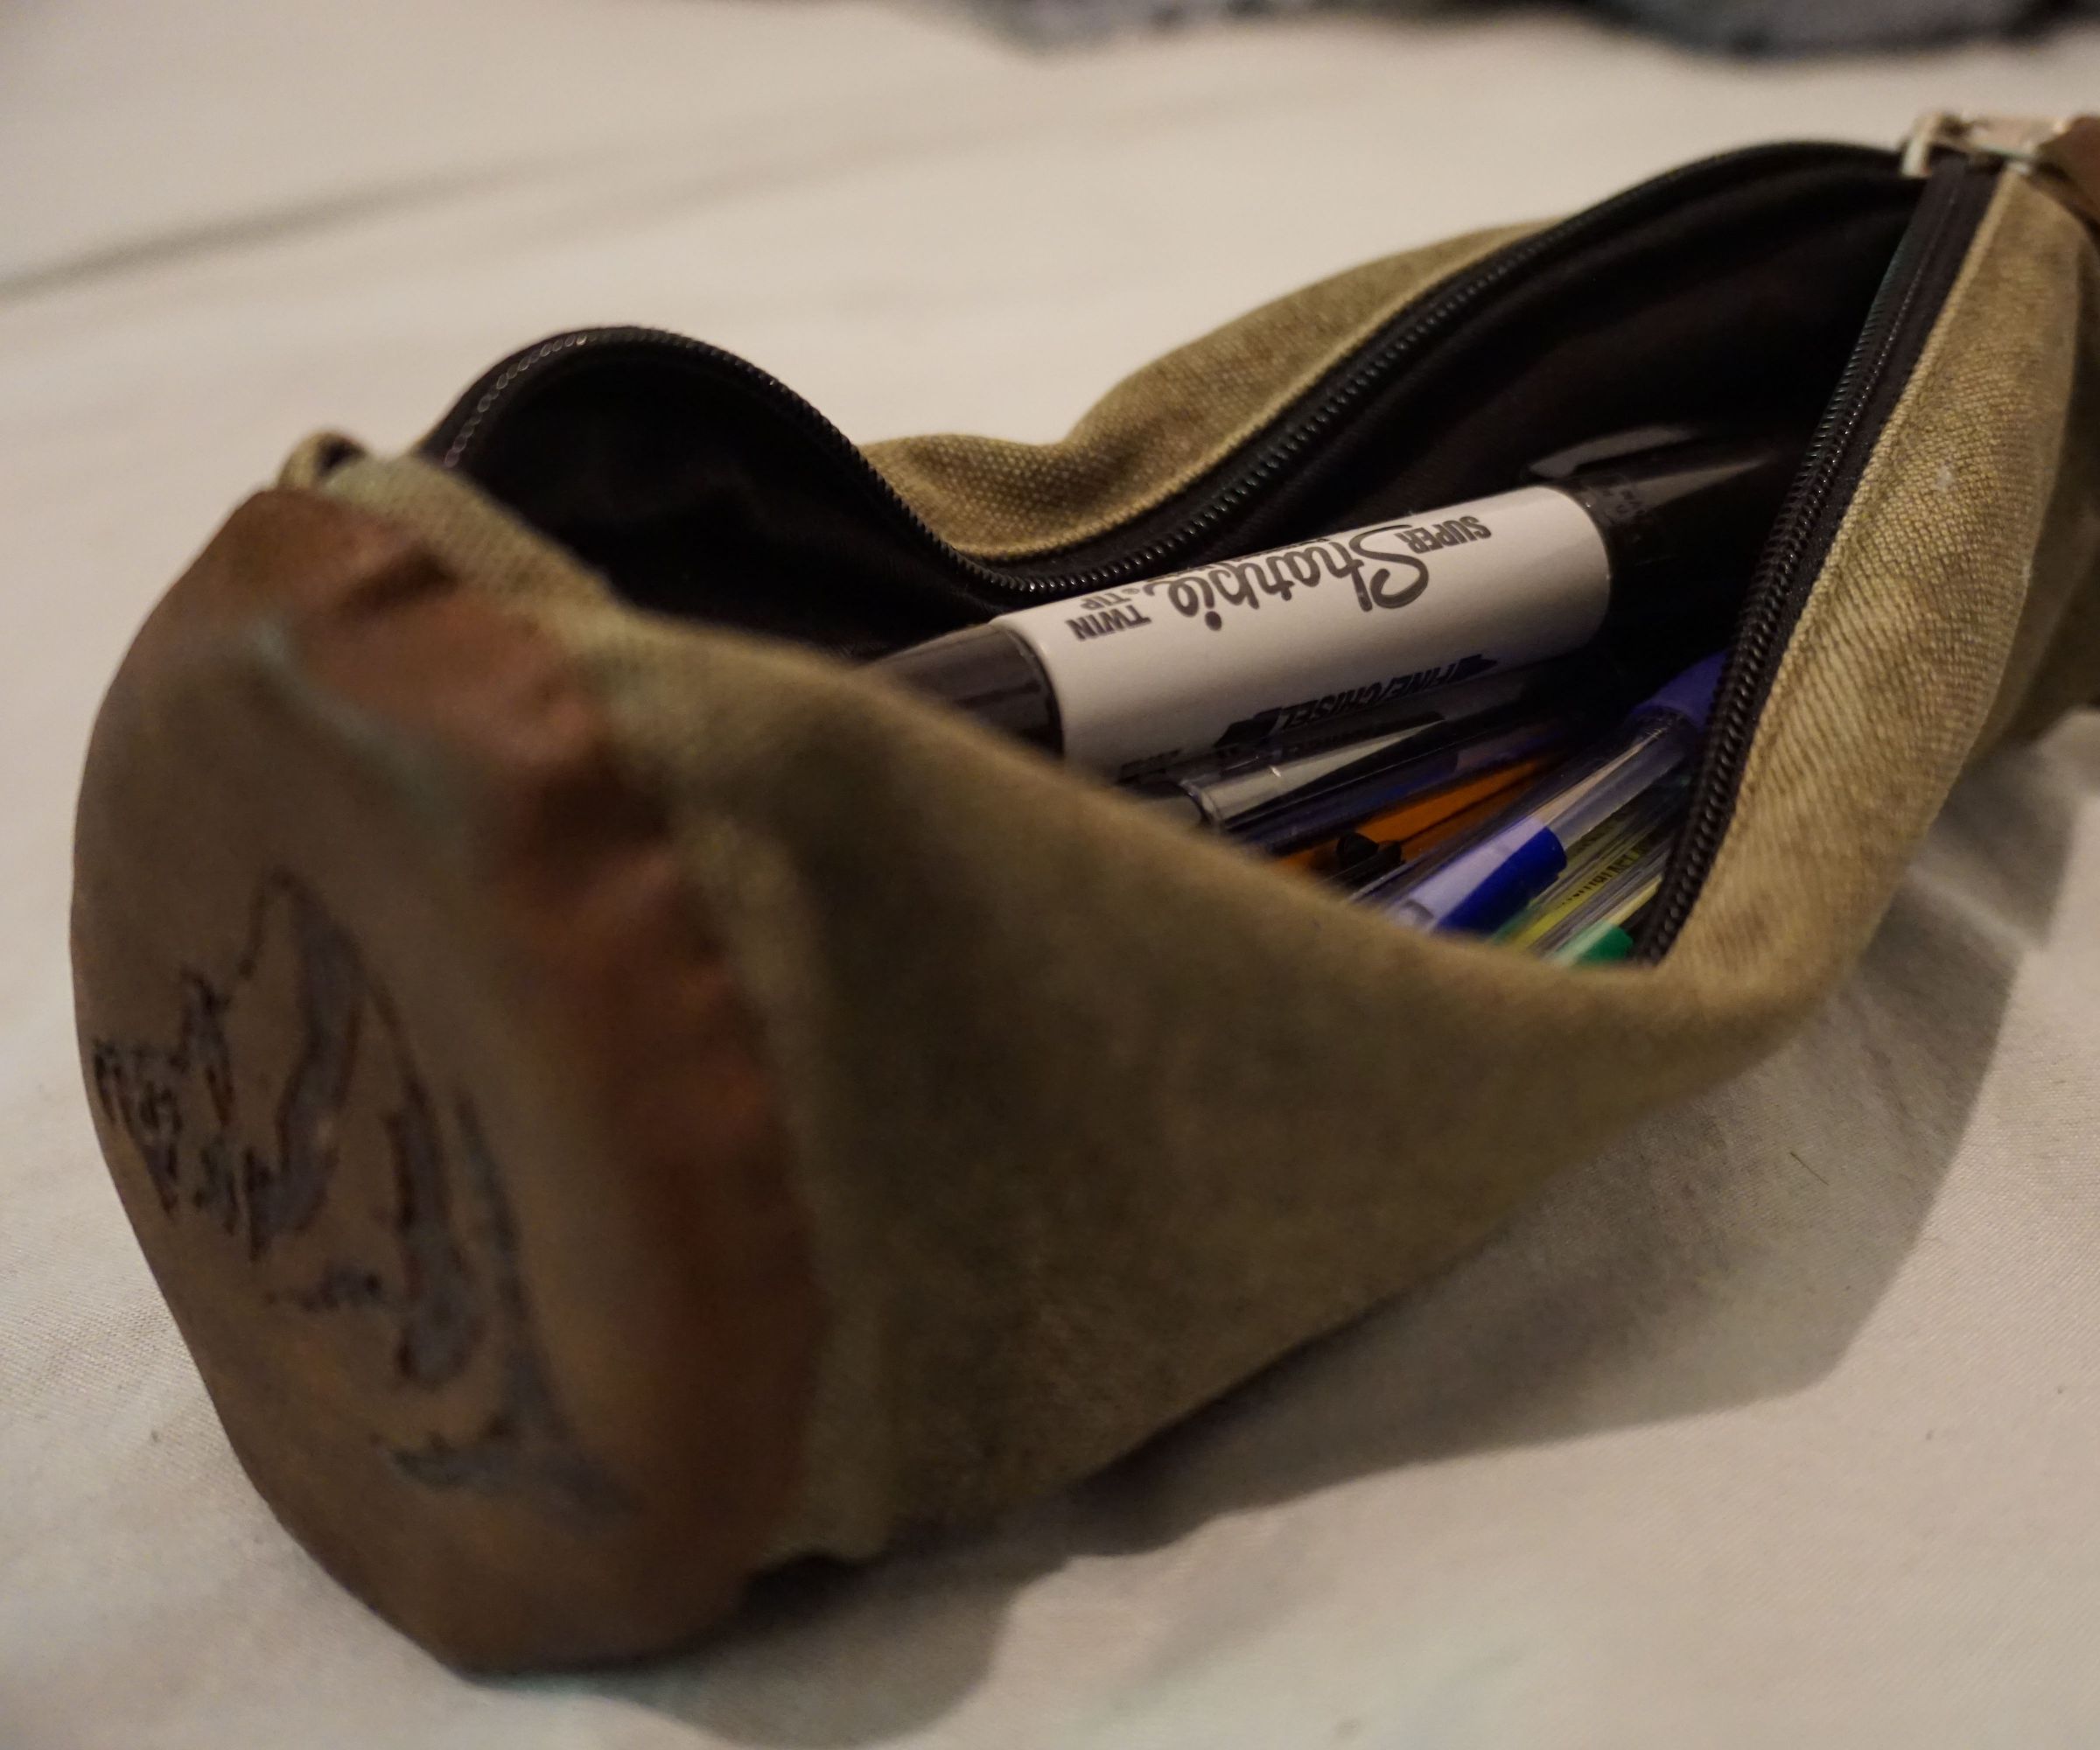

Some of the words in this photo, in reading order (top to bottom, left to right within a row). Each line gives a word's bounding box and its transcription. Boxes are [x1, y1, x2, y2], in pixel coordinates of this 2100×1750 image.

[1396, 515, 1492, 554] SUPER
[1144, 524, 1429, 631] Sharpie
[1081, 591, 1131, 610] TIP
[1066, 605, 1152, 641] TWIN
